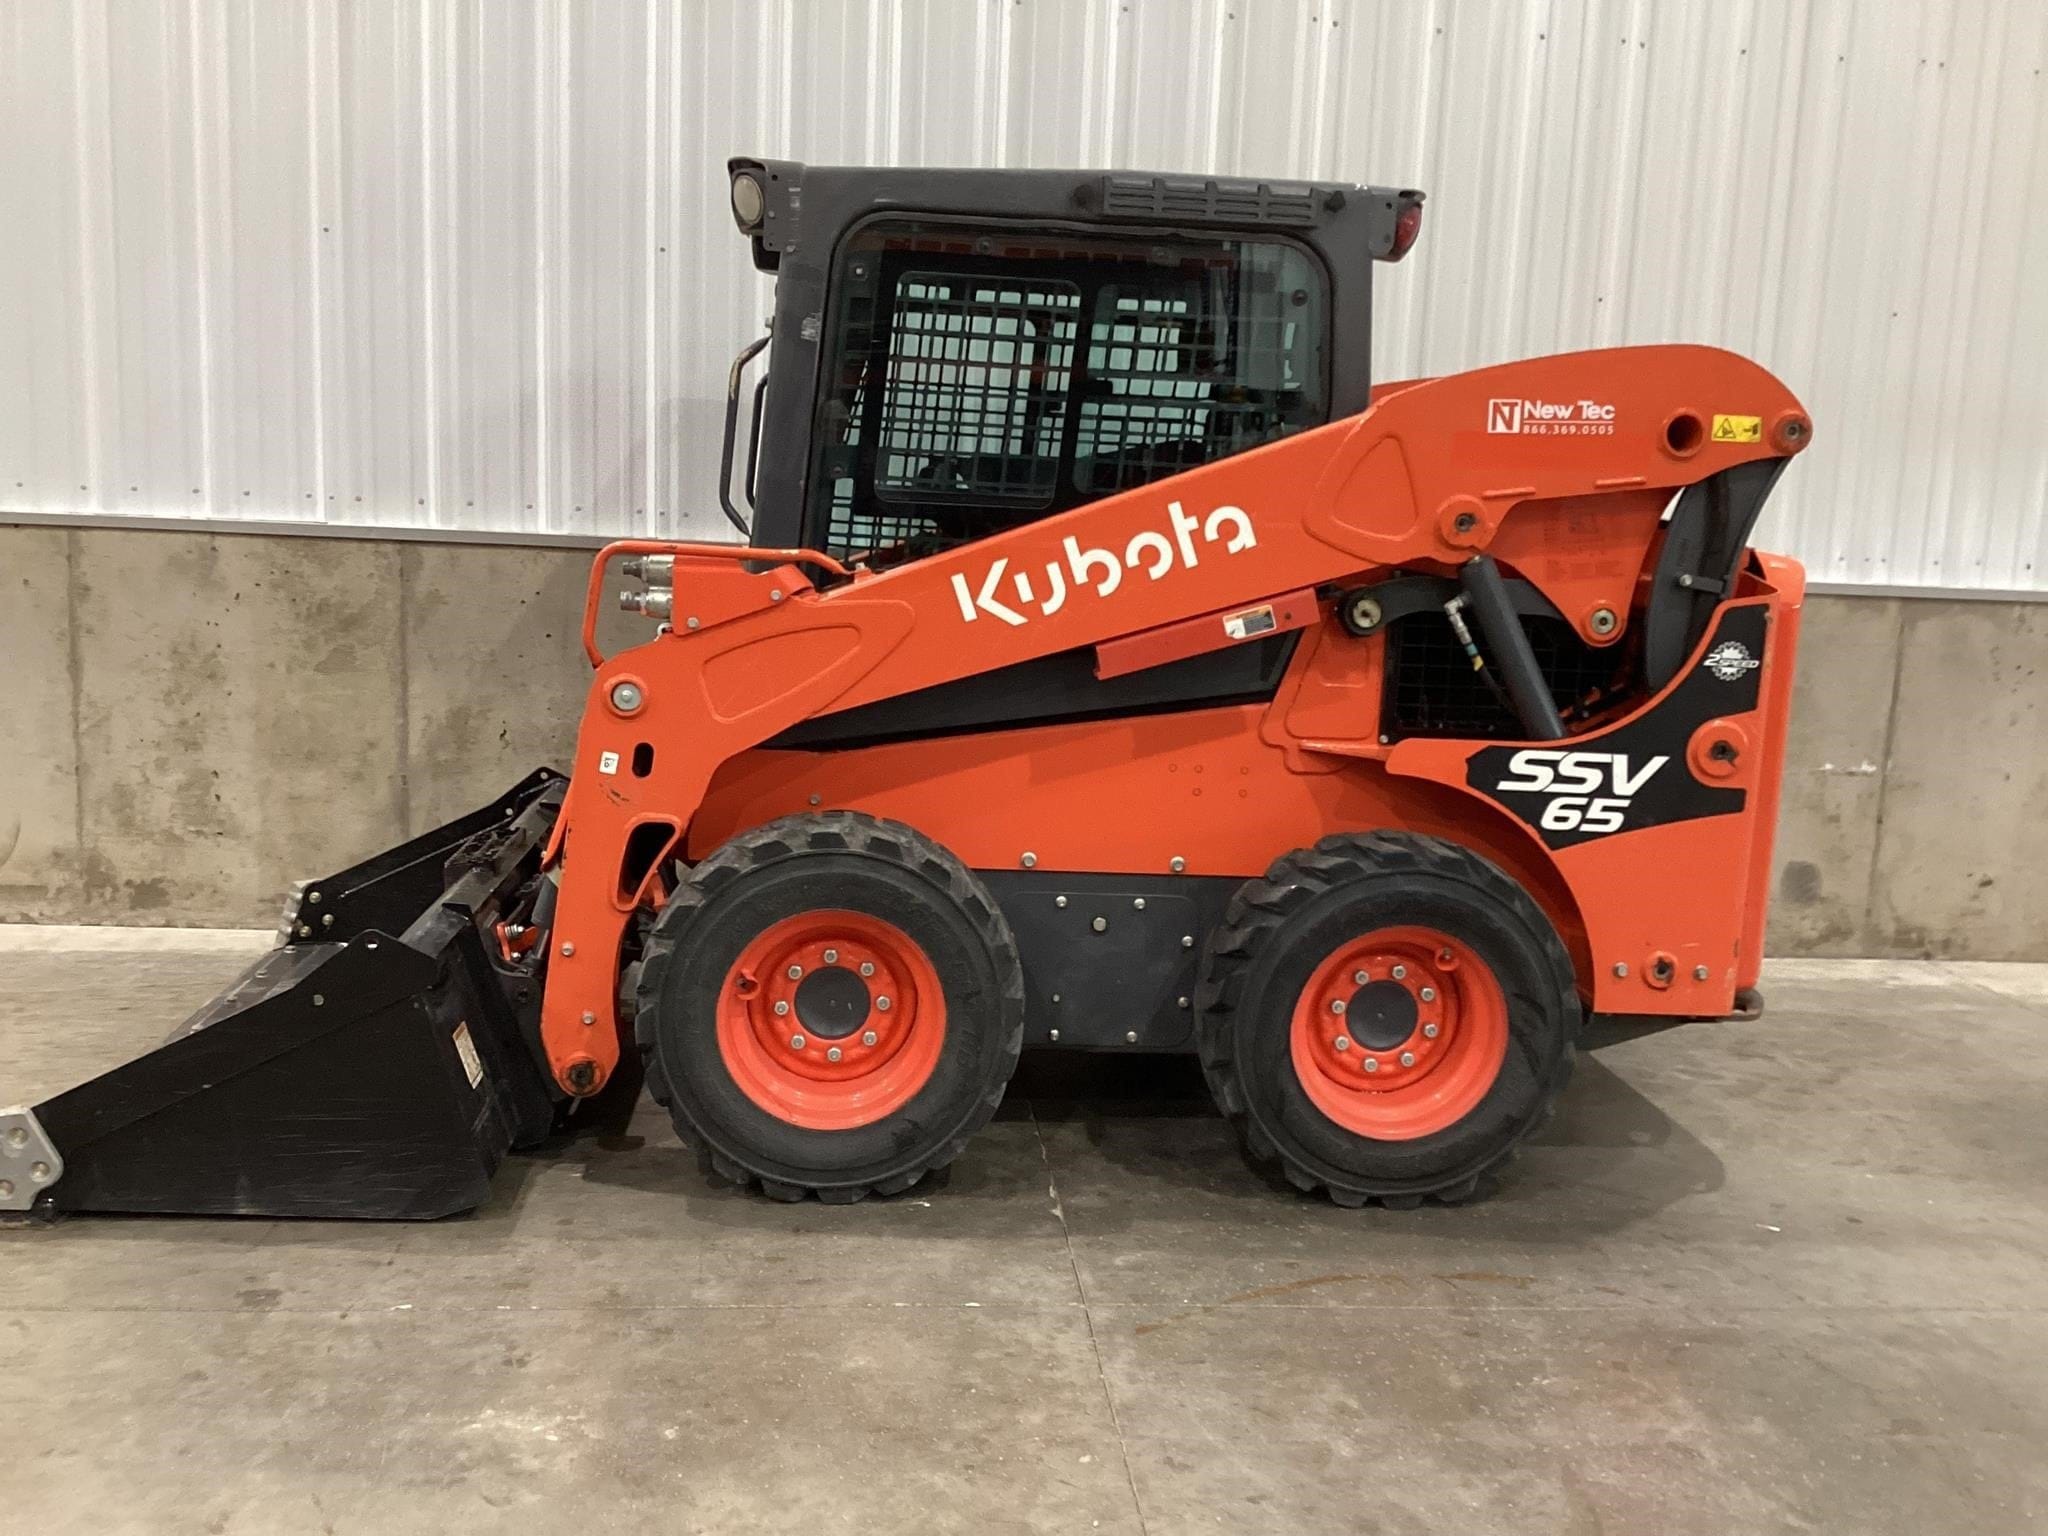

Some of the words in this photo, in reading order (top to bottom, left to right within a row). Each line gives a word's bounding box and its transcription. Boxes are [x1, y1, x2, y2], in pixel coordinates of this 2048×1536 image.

[1523, 400, 1575, 419] New
[1577, 400, 1616, 420] Tec
[1523, 425, 1614, 436] 866.369.0505
[950, 501, 1257, 626] Kubota
[1703, 653, 1721, 666] 2
[1496, 749, 1670, 796] SSV
[1540, 797, 1631, 833] 65
